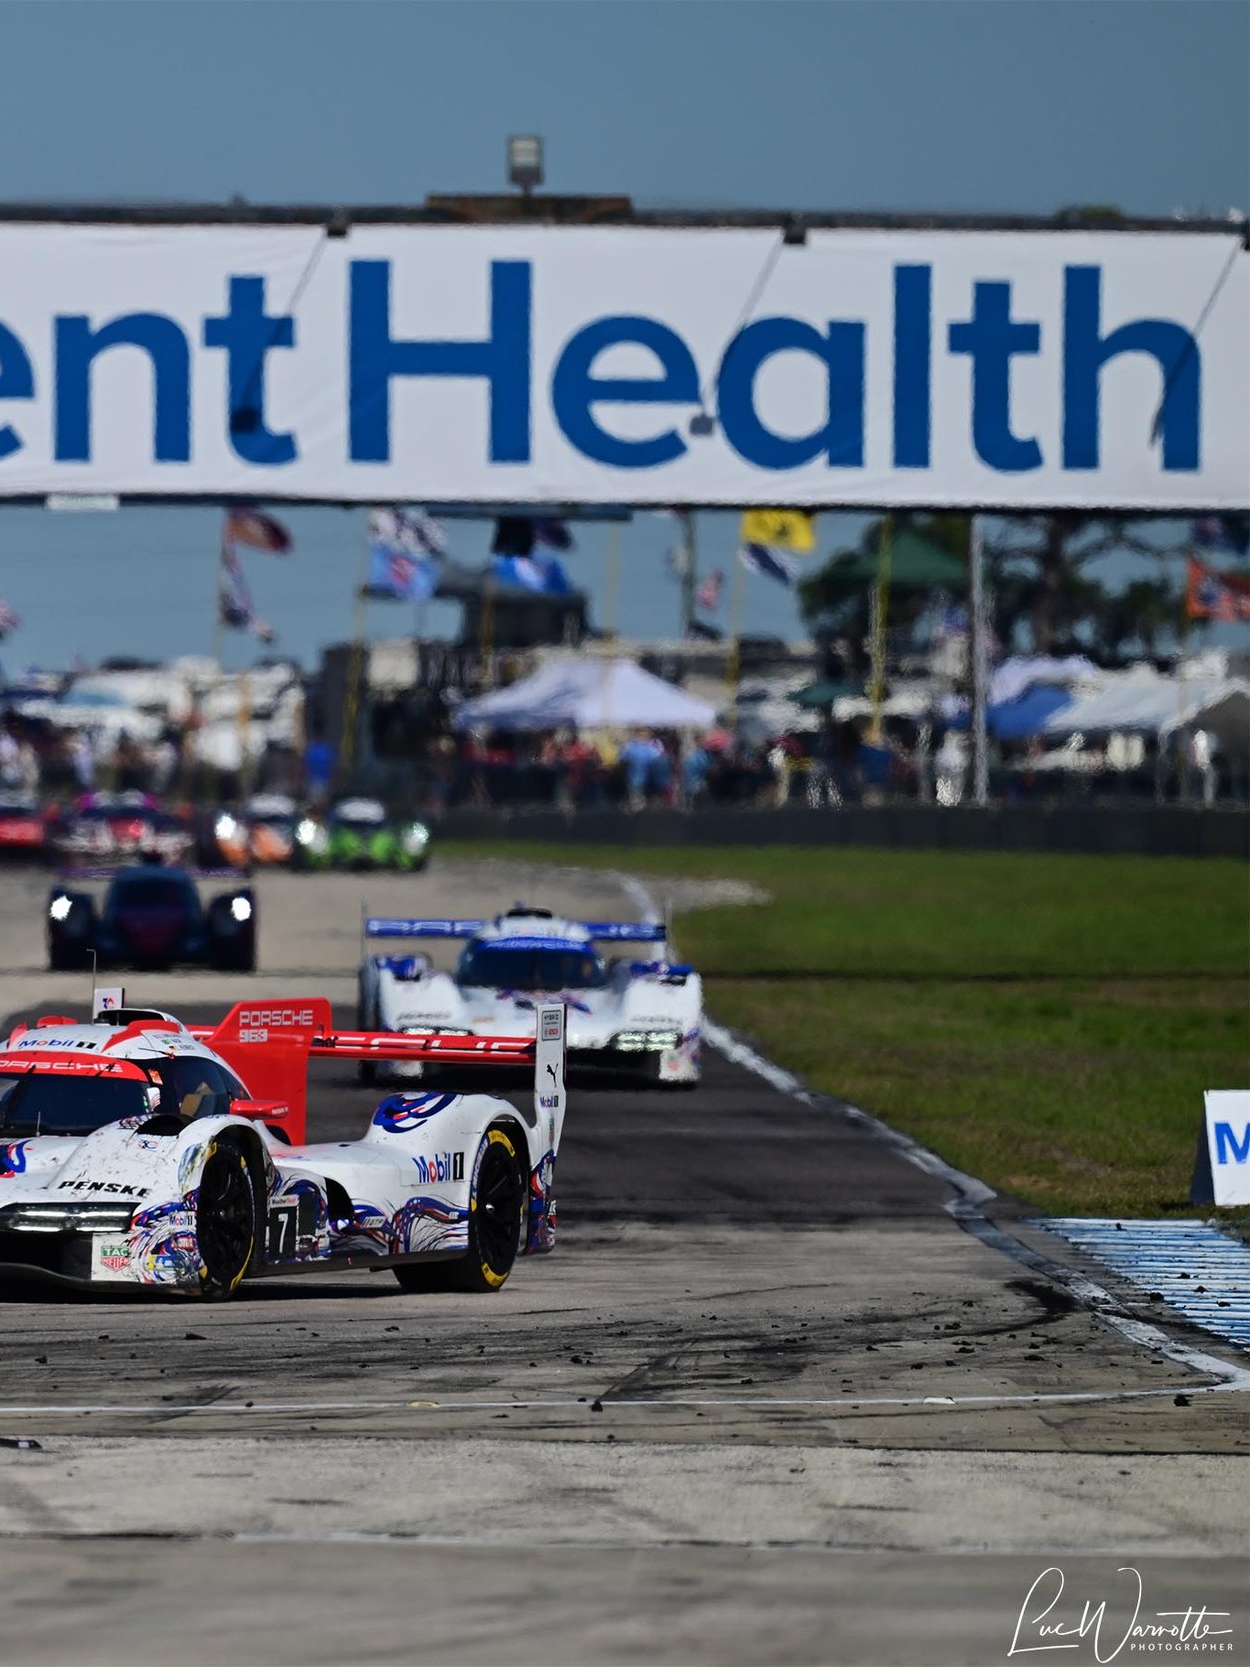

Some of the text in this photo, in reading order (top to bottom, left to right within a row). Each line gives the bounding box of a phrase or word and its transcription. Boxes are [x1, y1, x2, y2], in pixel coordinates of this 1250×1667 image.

[239, 1010, 313, 1027] PORSCHE
[18, 1039, 75, 1048] Mobil
[1214, 1121, 1250, 1165] M
[412, 1151, 464, 1184] Mobil 1
[58, 1181, 153, 1199] PENSKE
[278, 1213, 289, 1254] 7
[104, 1247, 129, 1256] TAG
[103, 1257, 130, 1271] HEUER
